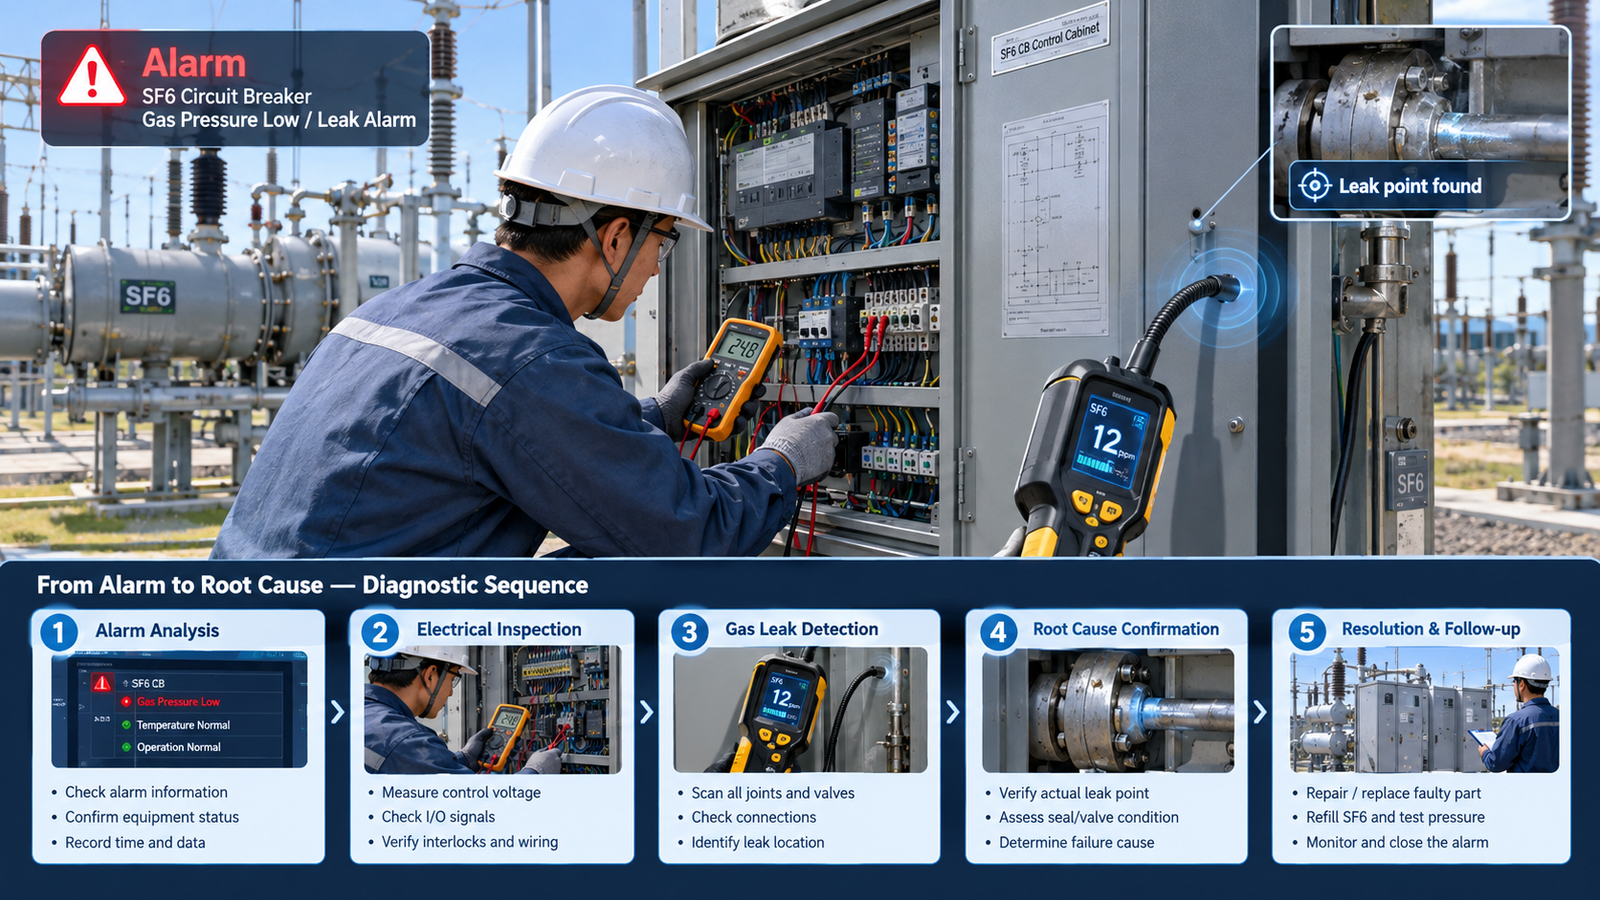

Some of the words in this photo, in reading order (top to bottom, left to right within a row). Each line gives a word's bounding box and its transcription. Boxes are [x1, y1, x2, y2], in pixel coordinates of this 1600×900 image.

[1000, 46, 1016, 60] SF6
[1018, 41, 1030, 55] CB
[1032, 32, 1063, 50] Control
[1065, 20, 1100, 41] Cabinet
[125, 285, 171, 307] SF6
[1089, 402, 1109, 417] SF6
[1093, 424, 1123, 456] 12
[1117, 449, 1136, 461] ppm
[1397, 472, 1425, 495] SF6
[131, 678, 151, 689] SF6
[151, 678, 166, 689] CB
[136, 696, 156, 707] Gas
[157, 696, 199, 707] Pressure
[200, 696, 221, 707] Low
[772, 688, 792, 707] 12
[136, 719, 195, 733] Temperature
[197, 720, 231, 730] Normal
[136, 742, 185, 755] Operation
[186, 741, 221, 752] Normal
